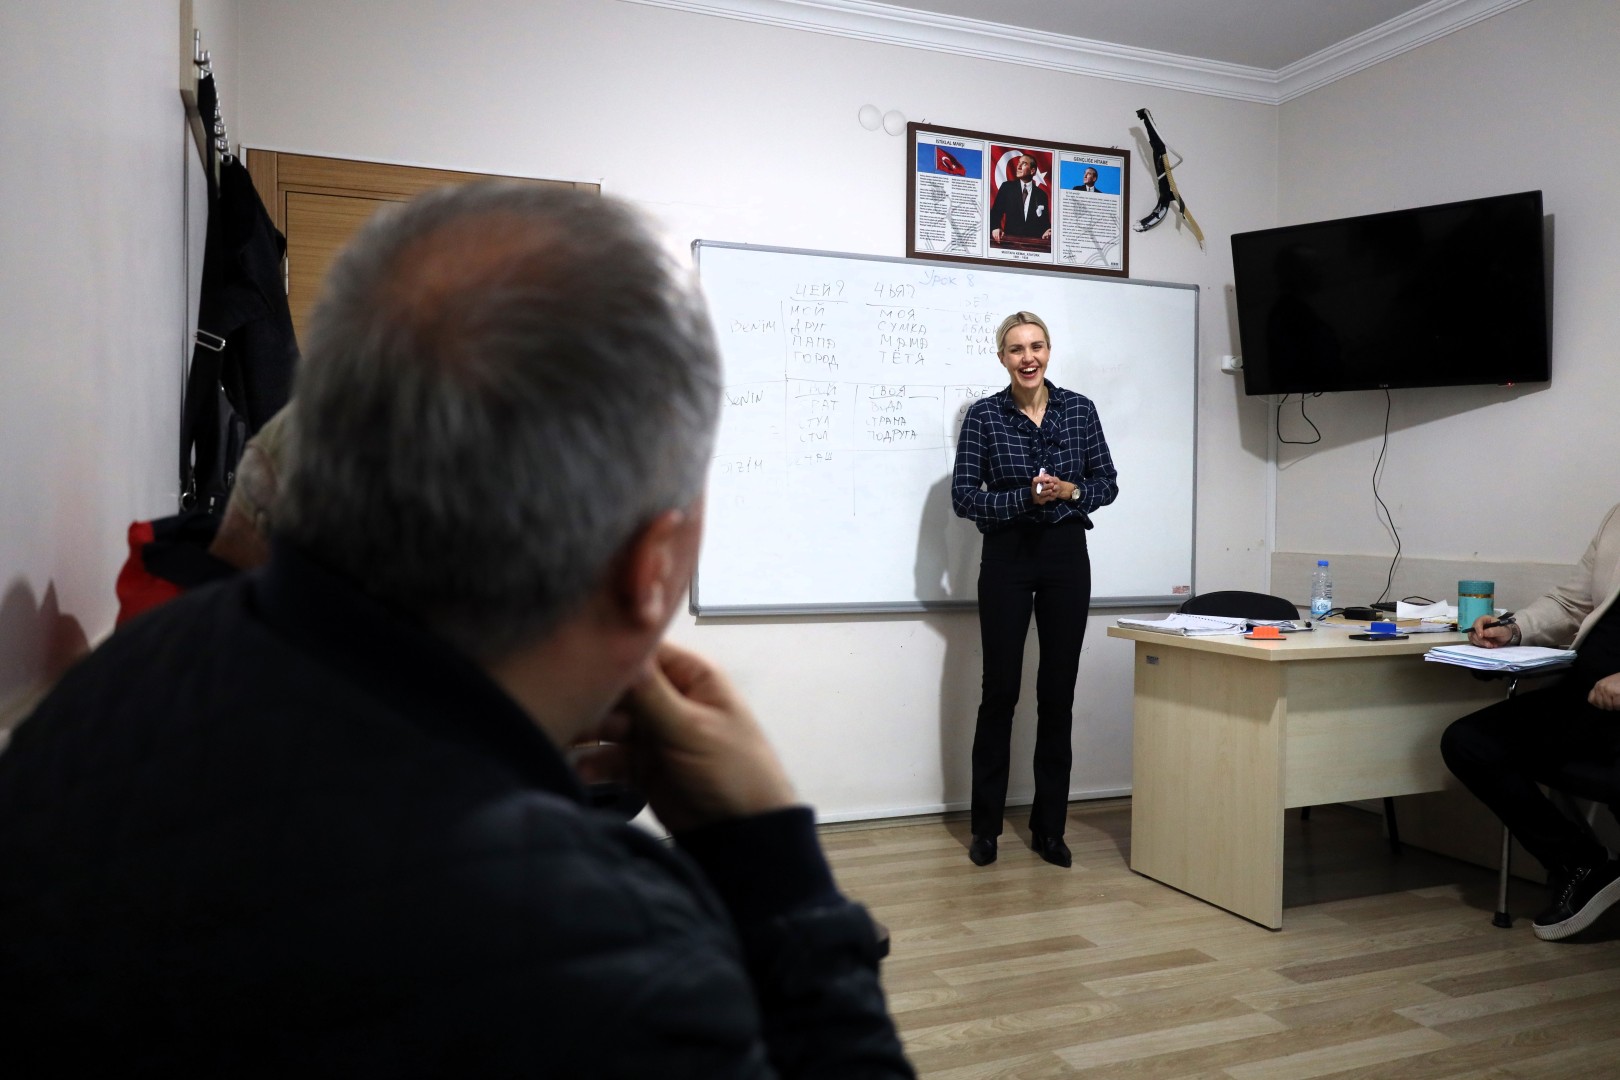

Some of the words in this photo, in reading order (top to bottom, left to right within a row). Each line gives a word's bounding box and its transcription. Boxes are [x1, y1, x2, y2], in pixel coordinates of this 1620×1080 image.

[918, 269, 959, 287] Урок
[966, 273, 975, 287] 8
[879, 308, 916, 321] МОЯ
[877, 320, 927, 335] СУМКА
[879, 333, 928, 350] МАМА
[794, 350, 840, 372] ГОРОД
[878, 347, 925, 366] ТЁТЯ
